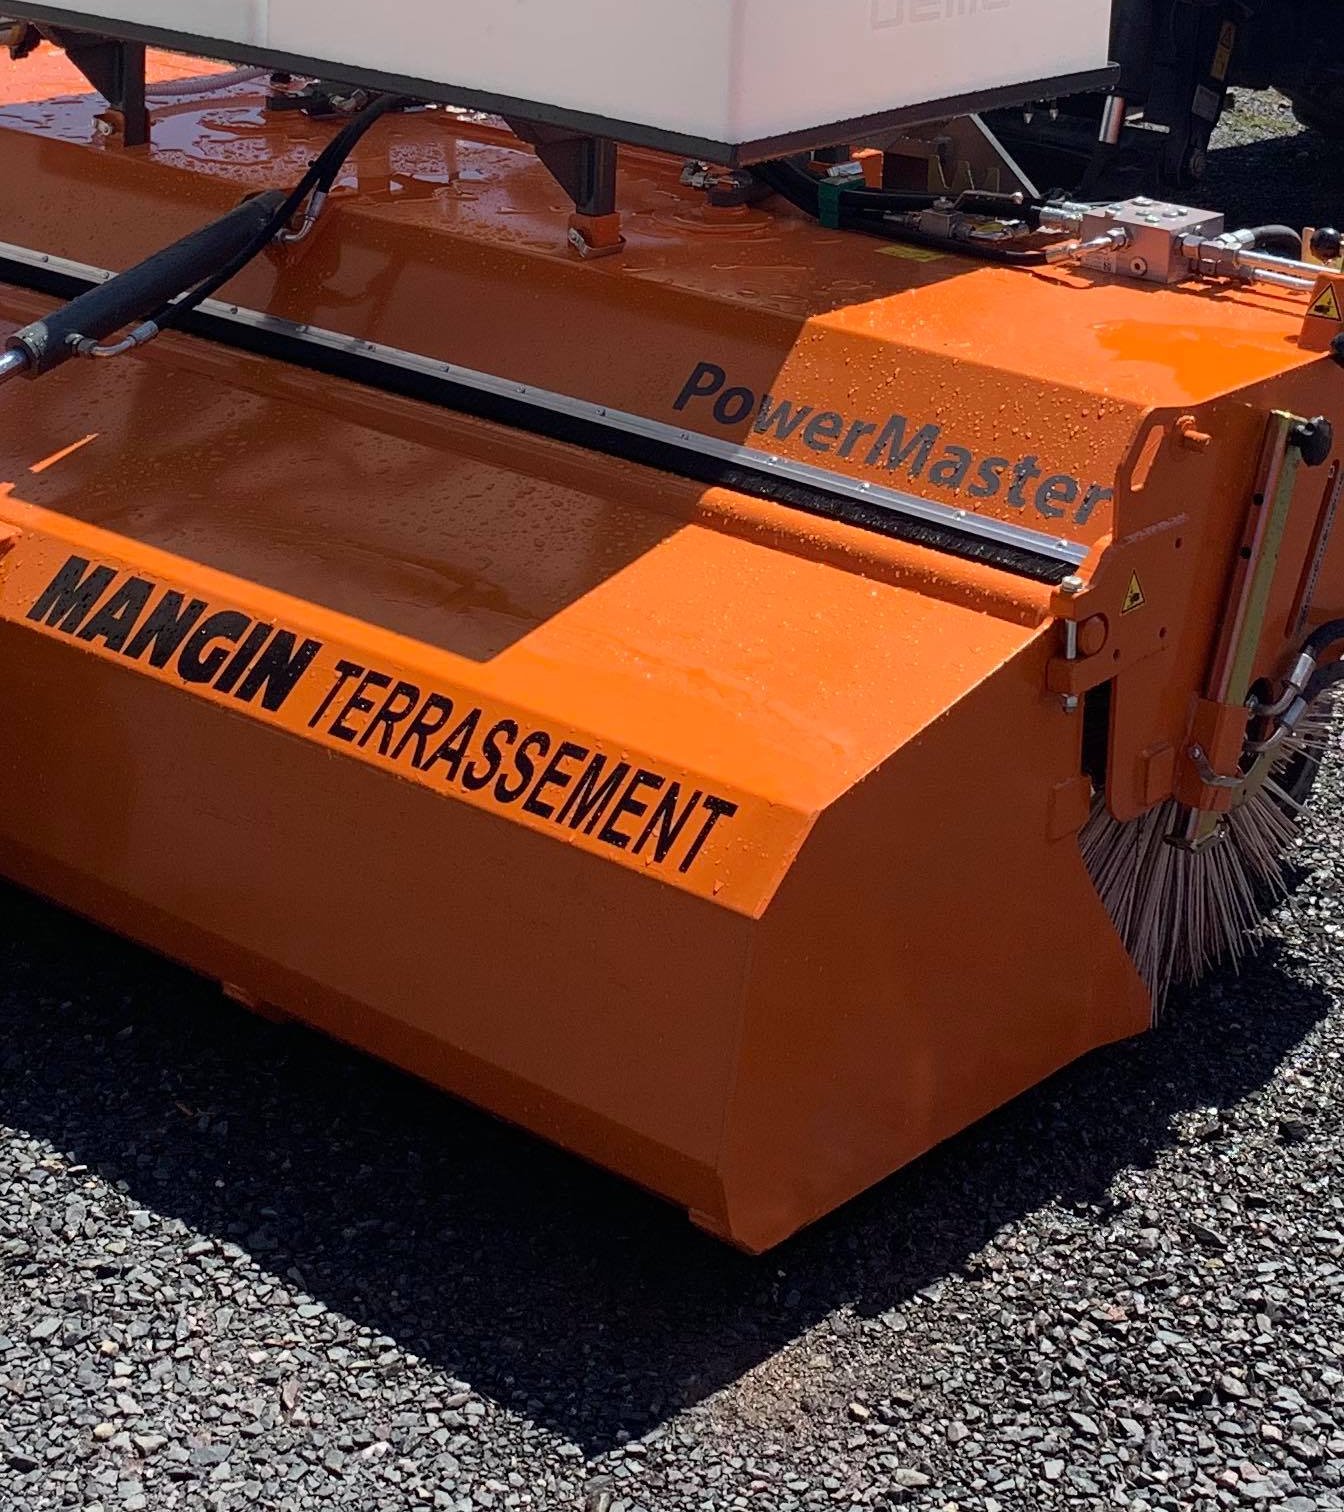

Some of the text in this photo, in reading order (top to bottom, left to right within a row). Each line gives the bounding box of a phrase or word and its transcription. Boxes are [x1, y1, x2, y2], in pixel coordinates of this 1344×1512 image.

[672, 361, 1113, 525] PowerMaster
[26, 554, 738, 875] MANGIN TERRASSEMENT
